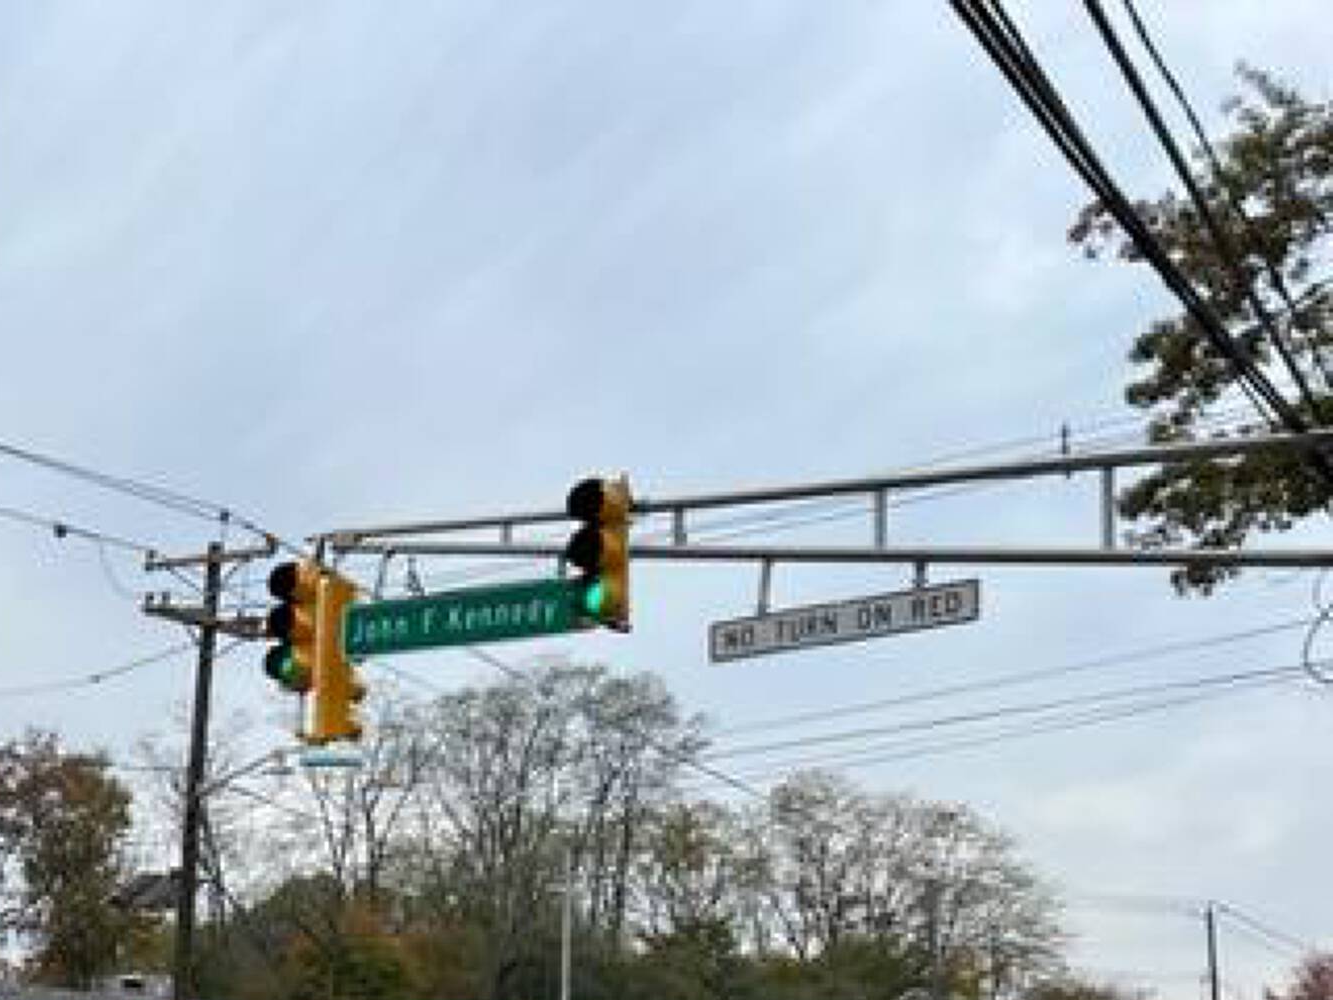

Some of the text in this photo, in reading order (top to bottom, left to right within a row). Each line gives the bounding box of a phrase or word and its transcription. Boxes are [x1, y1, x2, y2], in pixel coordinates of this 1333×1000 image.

[352, 614, 408, 643] John
[447, 597, 558, 632] Kennedy
[721, 591, 962, 649] NO TURN ON RED
